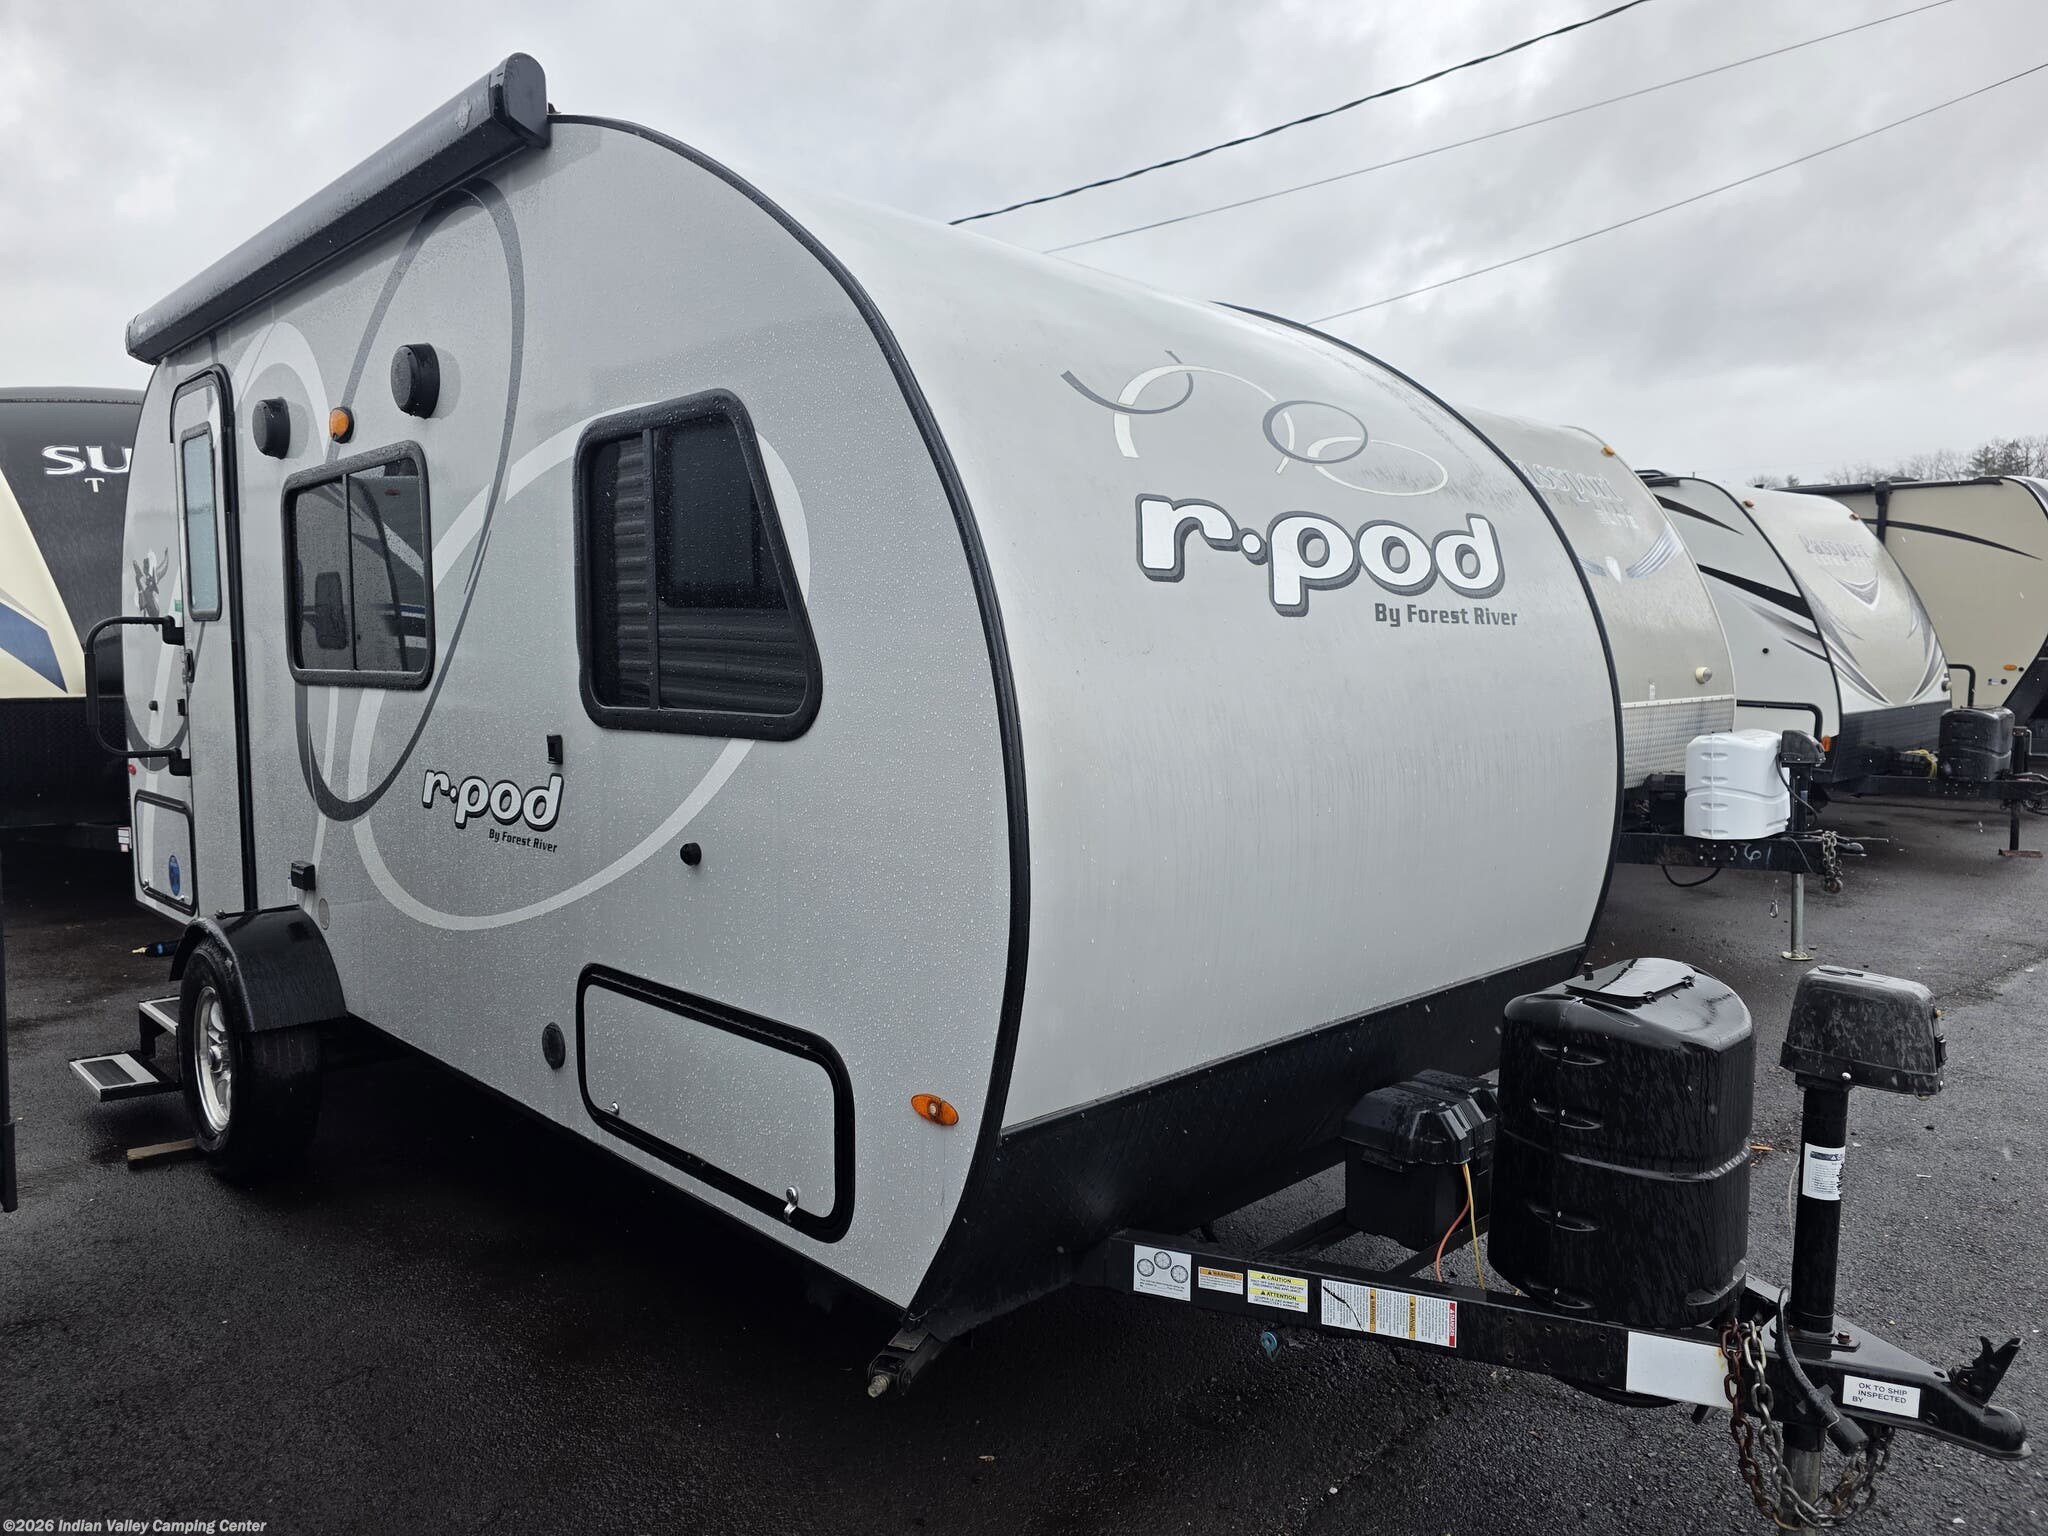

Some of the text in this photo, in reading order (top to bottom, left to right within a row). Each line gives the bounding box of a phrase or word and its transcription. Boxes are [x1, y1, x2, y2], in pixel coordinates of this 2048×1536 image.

[1374, 602, 1519, 627] By Forest River
[488, 828, 558, 853] By Forest River
[1266, 1274, 1292, 1284] CAUTION
[1266, 1291, 1297, 1301] ATTENTION
[1858, 1382, 1908, 1396] OK TO SHIP
[1852, 1395, 1864, 1403] BY
[1857, 1390, 1907, 1404] INSPECTED
